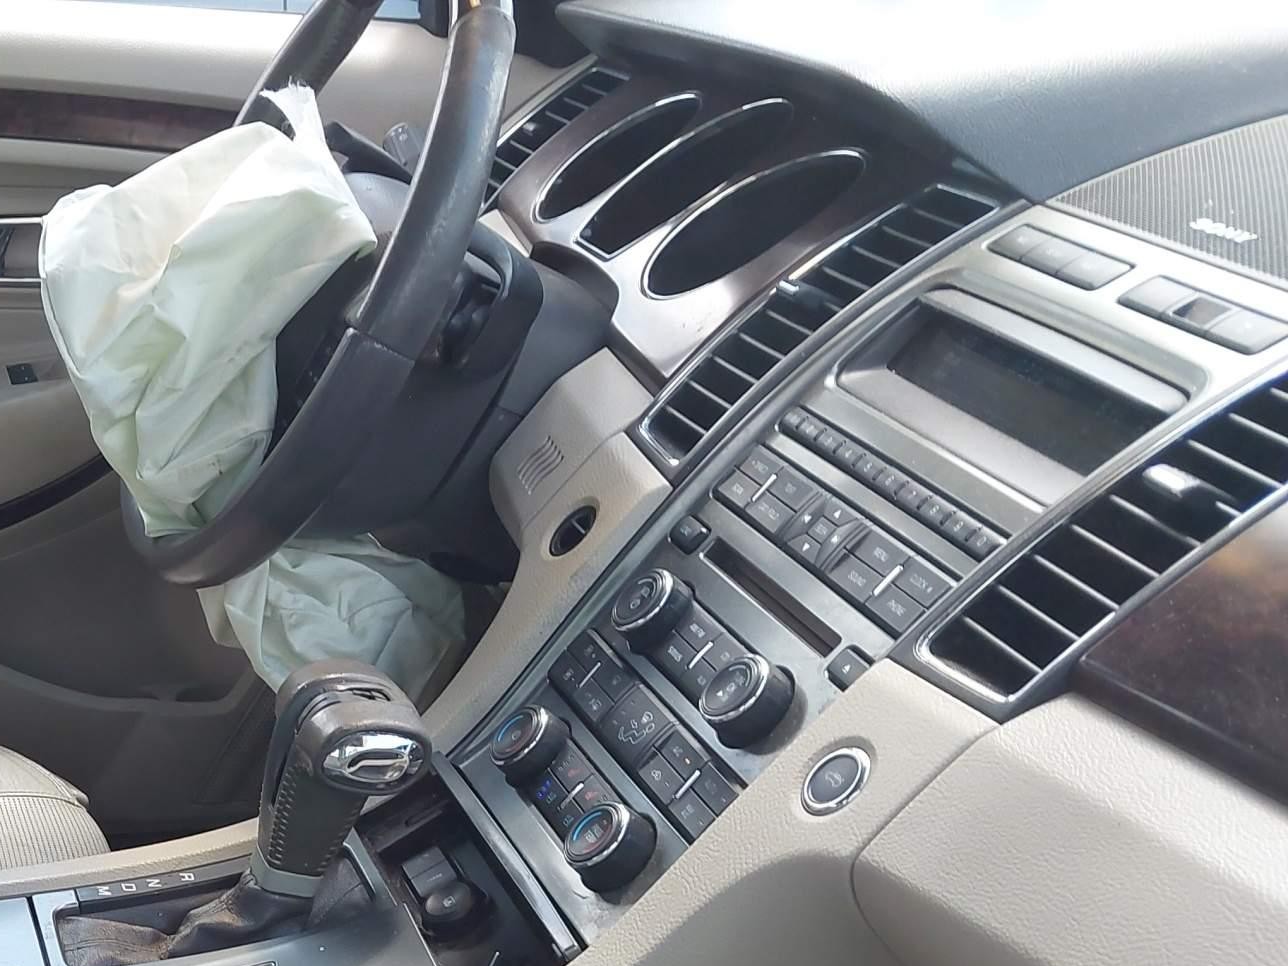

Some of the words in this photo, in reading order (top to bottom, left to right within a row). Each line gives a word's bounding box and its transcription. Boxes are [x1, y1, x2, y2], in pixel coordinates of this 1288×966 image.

[1189, 217, 1257, 244] SONY
[120, 883, 137, 892] D
[145, 878, 162, 888] N
[95, 886, 112, 896] M
